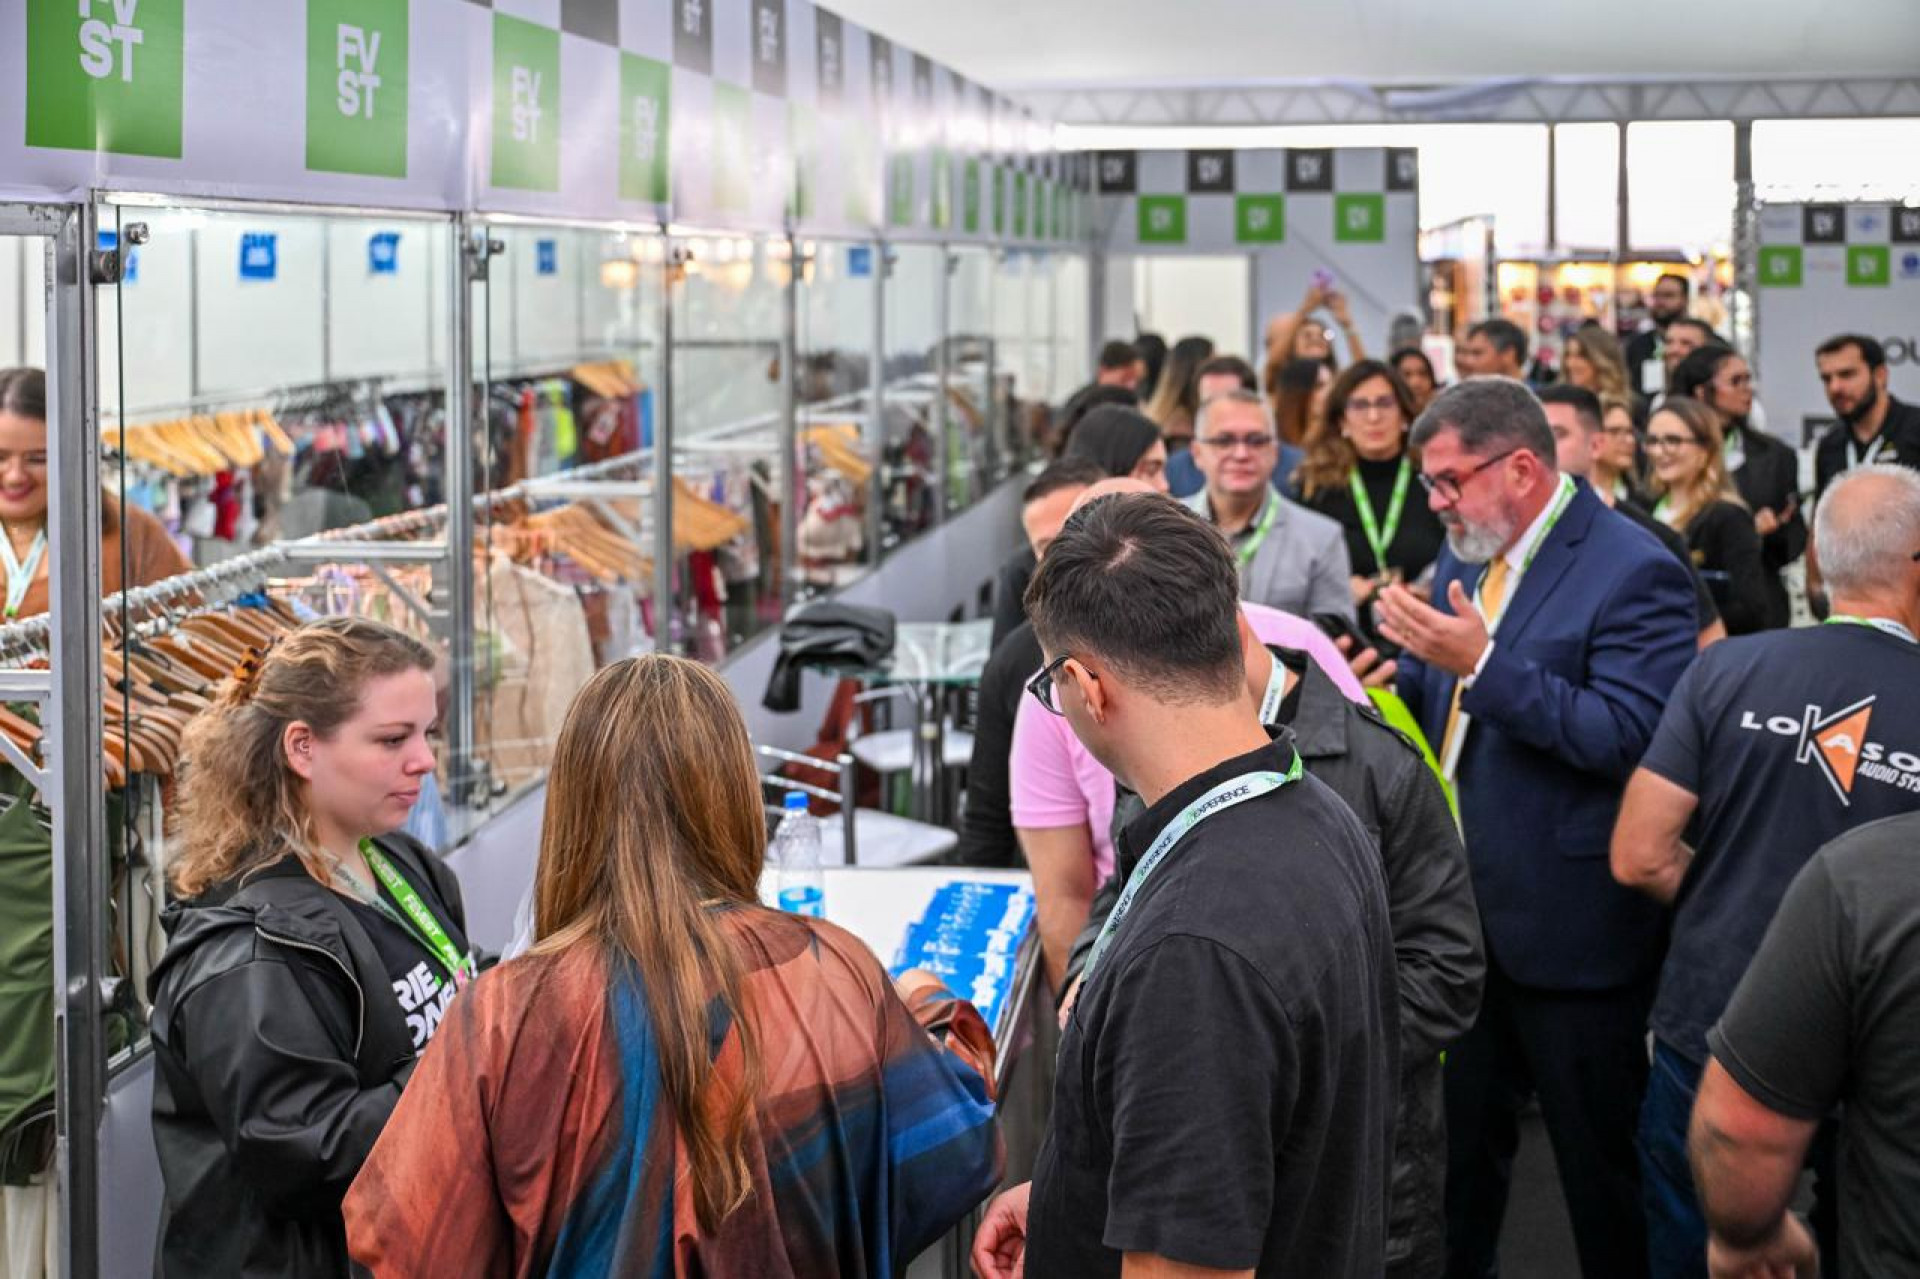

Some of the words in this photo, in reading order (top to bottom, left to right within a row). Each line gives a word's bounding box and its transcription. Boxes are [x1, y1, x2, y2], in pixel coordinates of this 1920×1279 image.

[79, 20, 144, 82] ST
[337, 23, 381, 72] FV
[337, 69, 381, 119] ST
[512, 66, 542, 111] FV
[512, 104, 542, 144] ST
[1856, 761, 1900, 784] AUDIO
